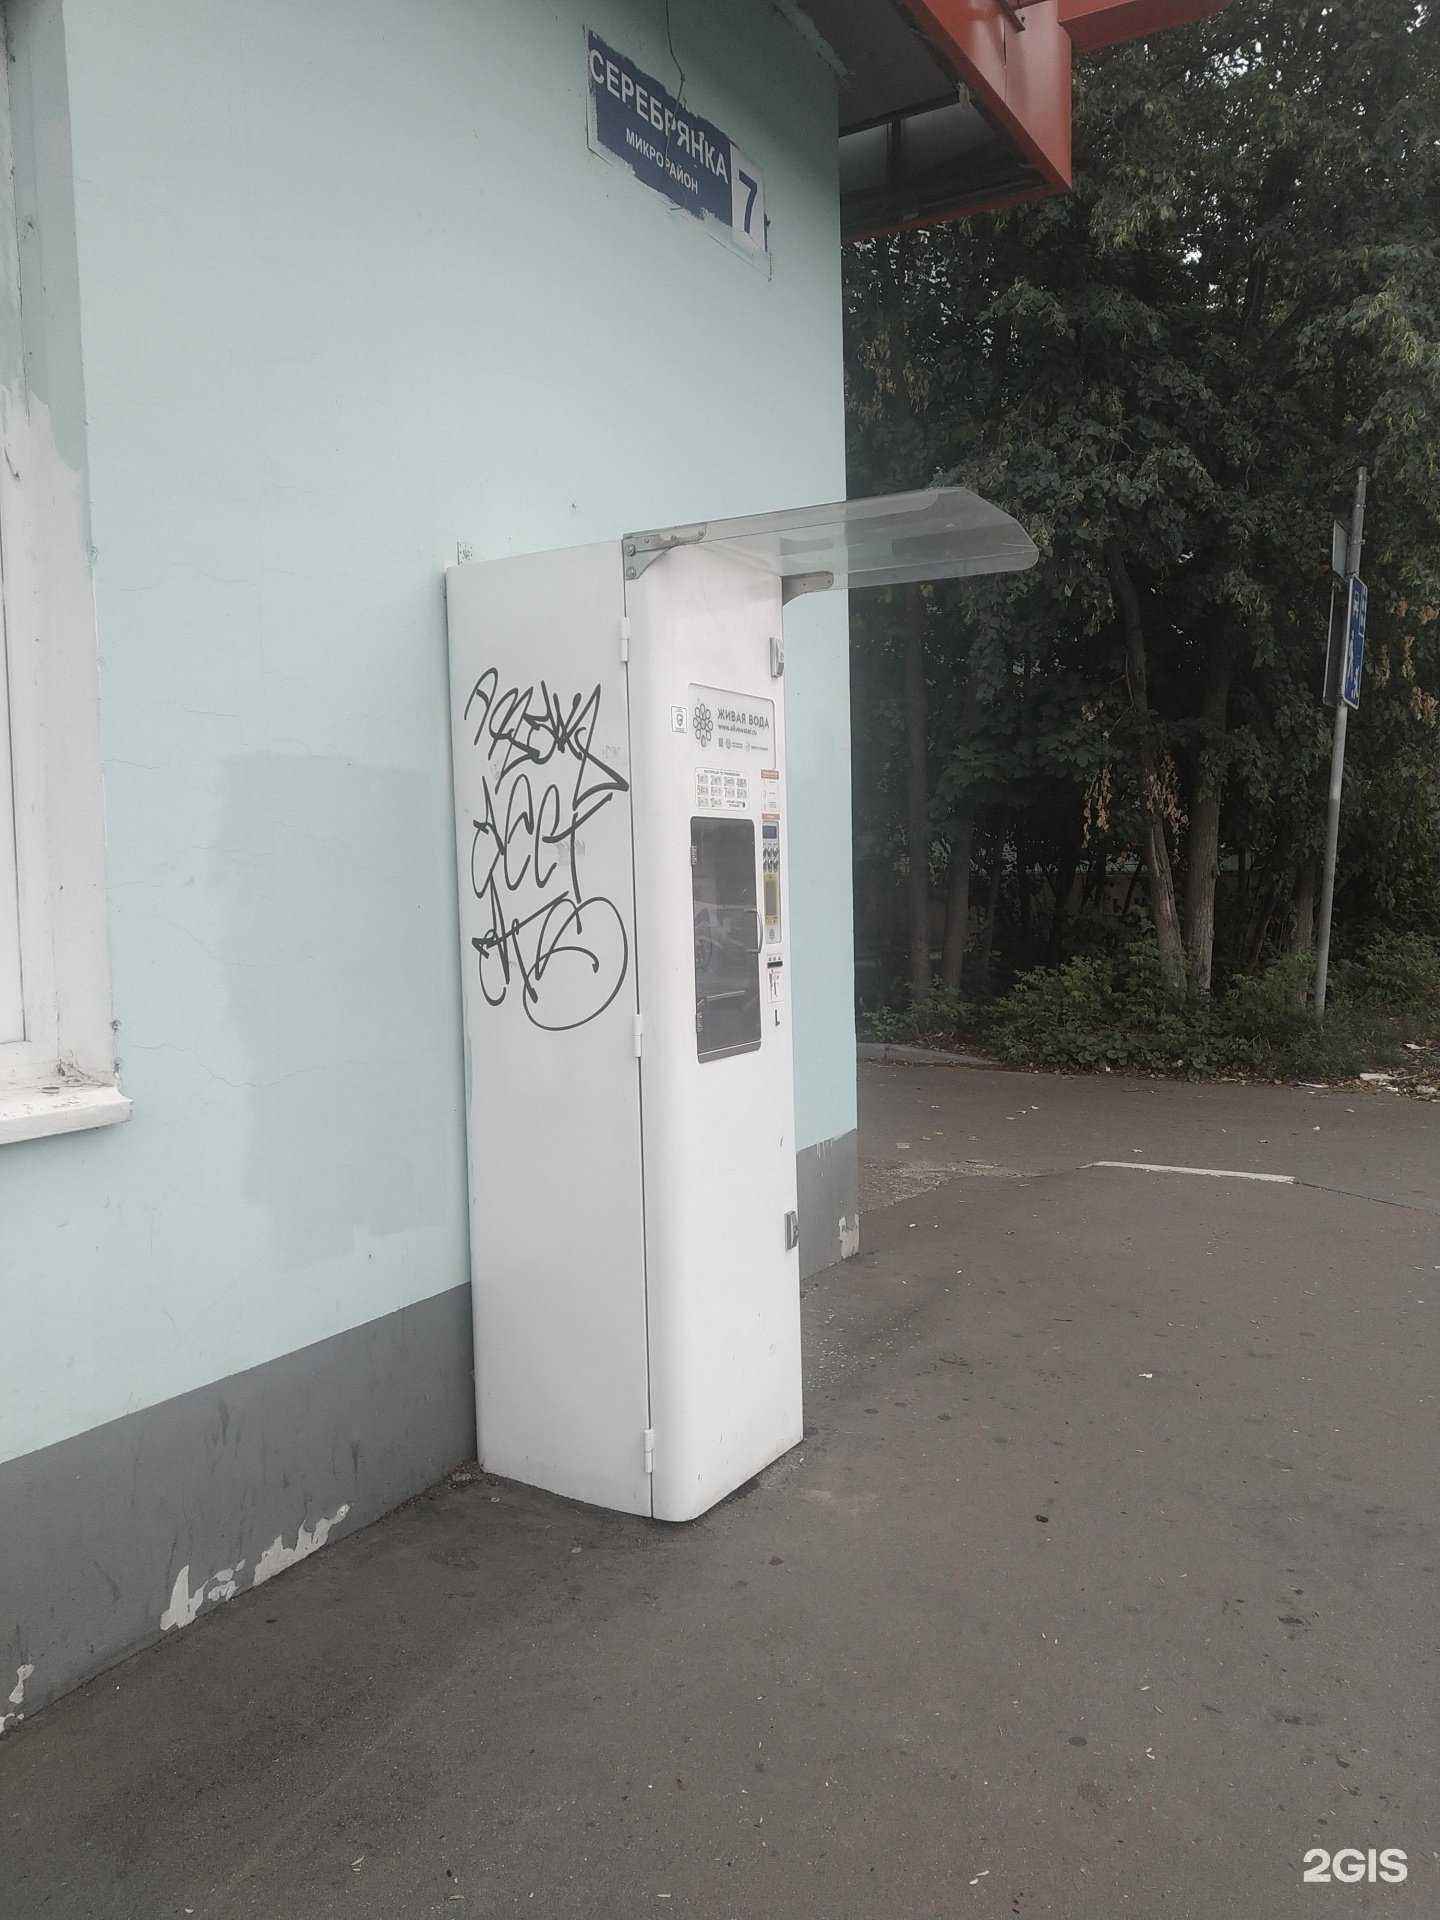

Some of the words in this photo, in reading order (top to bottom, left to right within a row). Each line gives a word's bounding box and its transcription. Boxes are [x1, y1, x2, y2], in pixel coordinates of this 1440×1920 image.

[589, 49, 728, 184] СЕРЕБРЯНКА
[626, 128, 698, 194] МИКРОРАЙОН
[738, 169, 758, 234] 7
[717, 708, 746, 725] ЖИВАЯ
[748, 714, 770, 729] ВОДА
